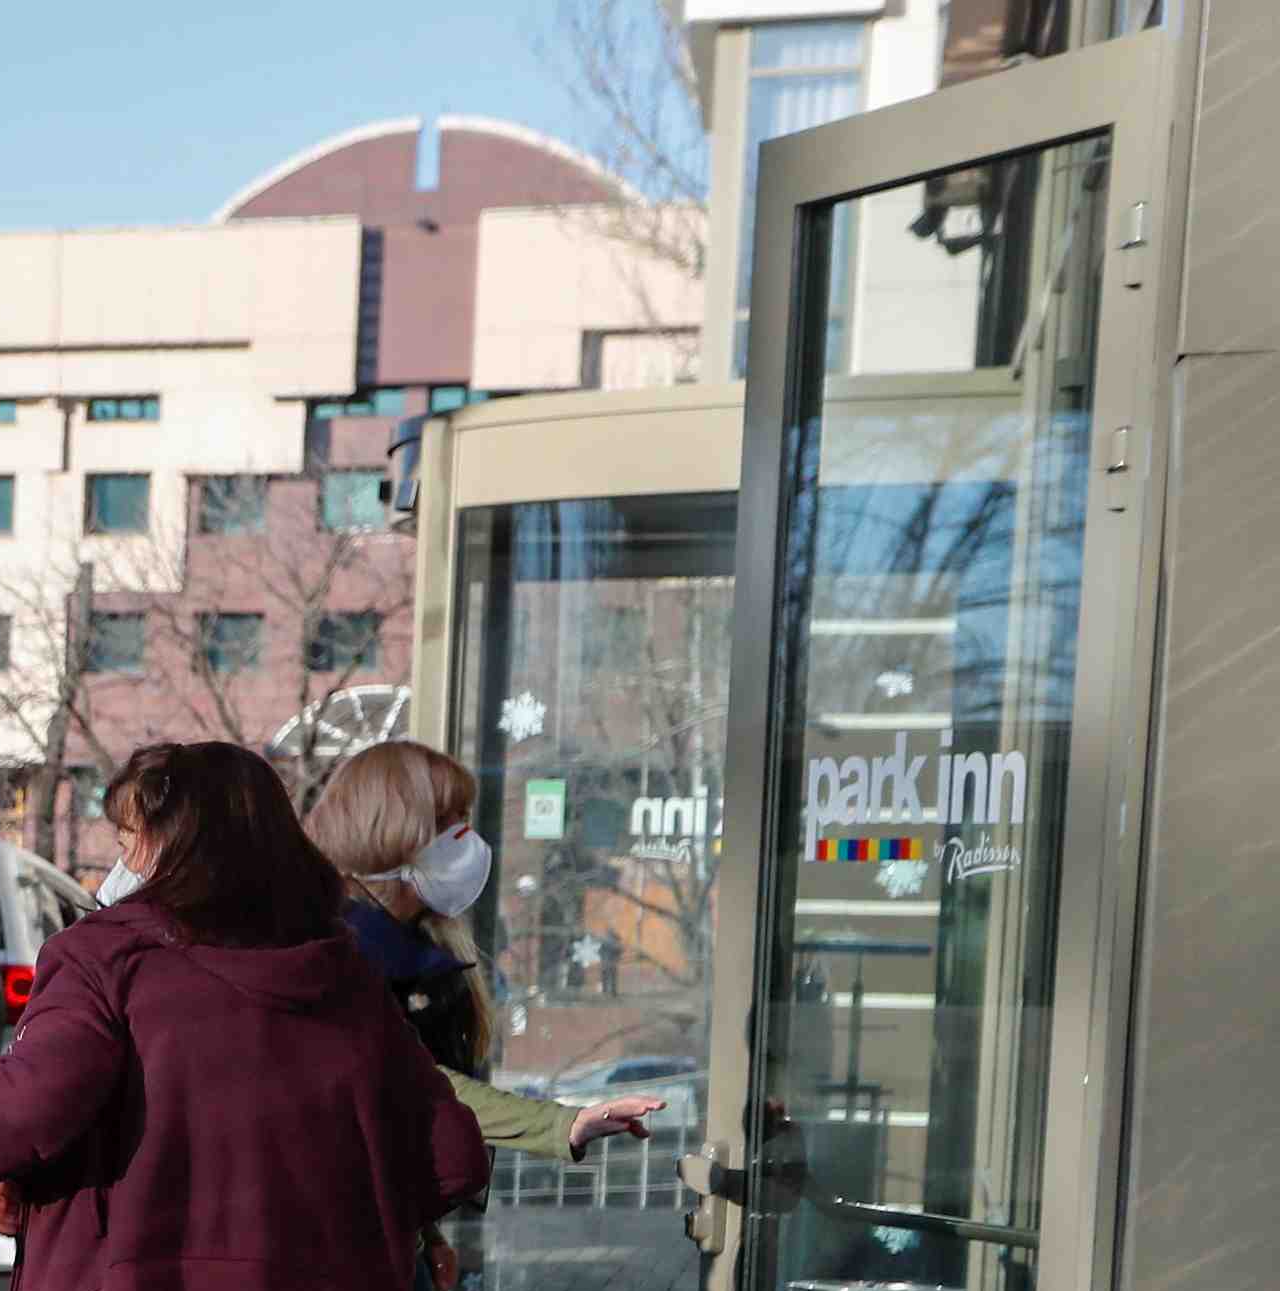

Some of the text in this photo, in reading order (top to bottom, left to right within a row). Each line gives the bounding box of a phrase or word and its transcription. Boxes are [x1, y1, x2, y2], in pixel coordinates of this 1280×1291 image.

[804, 727, 1027, 863] park inn
[946, 831, 1022, 885] Radisson
